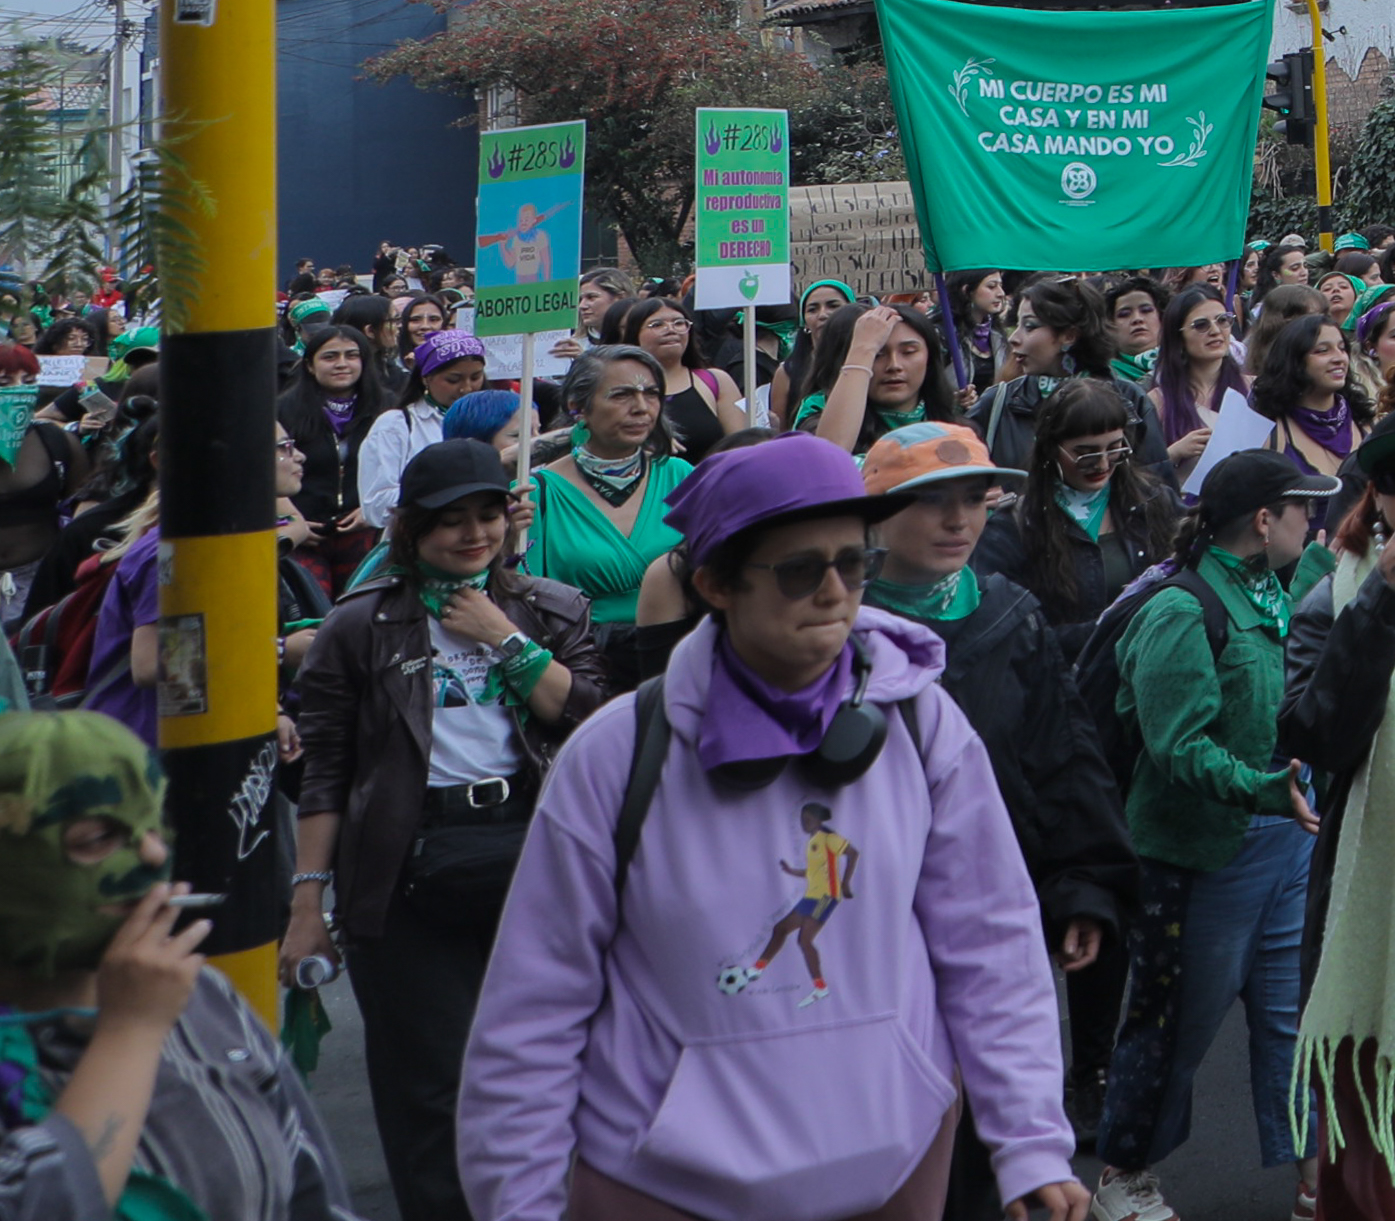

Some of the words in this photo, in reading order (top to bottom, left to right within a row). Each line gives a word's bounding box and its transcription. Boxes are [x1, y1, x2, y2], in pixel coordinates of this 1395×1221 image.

[978, 78, 1005, 98] MI
[1010, 80, 1103, 104] CUERPO
[1108, 84, 1134, 104] ES
[1139, 83, 1167, 103] MI
[999, 105, 1060, 128] CASA
[1064, 109, 1082, 128] Y
[1087, 109, 1115, 129] EN
[1121, 109, 1149, 129] MI
[723, 123, 769, 152] #28S
[977, 131, 1041, 155] CASA
[1044, 135, 1132, 156] MANDO
[1137, 135, 1175, 156] YO
[508, 141, 558, 173] #28S
[703, 169, 719, 186] Mi
[722, 168, 783, 186] autonomía
[705, 192, 782, 212] reproductiva
[731, 220, 749, 235] es
[752, 219, 765, 234] un
[719, 240, 772, 259] DERECHO
[476, 296, 533, 319] ABORTO
[534, 291, 577, 314] LEGAL
